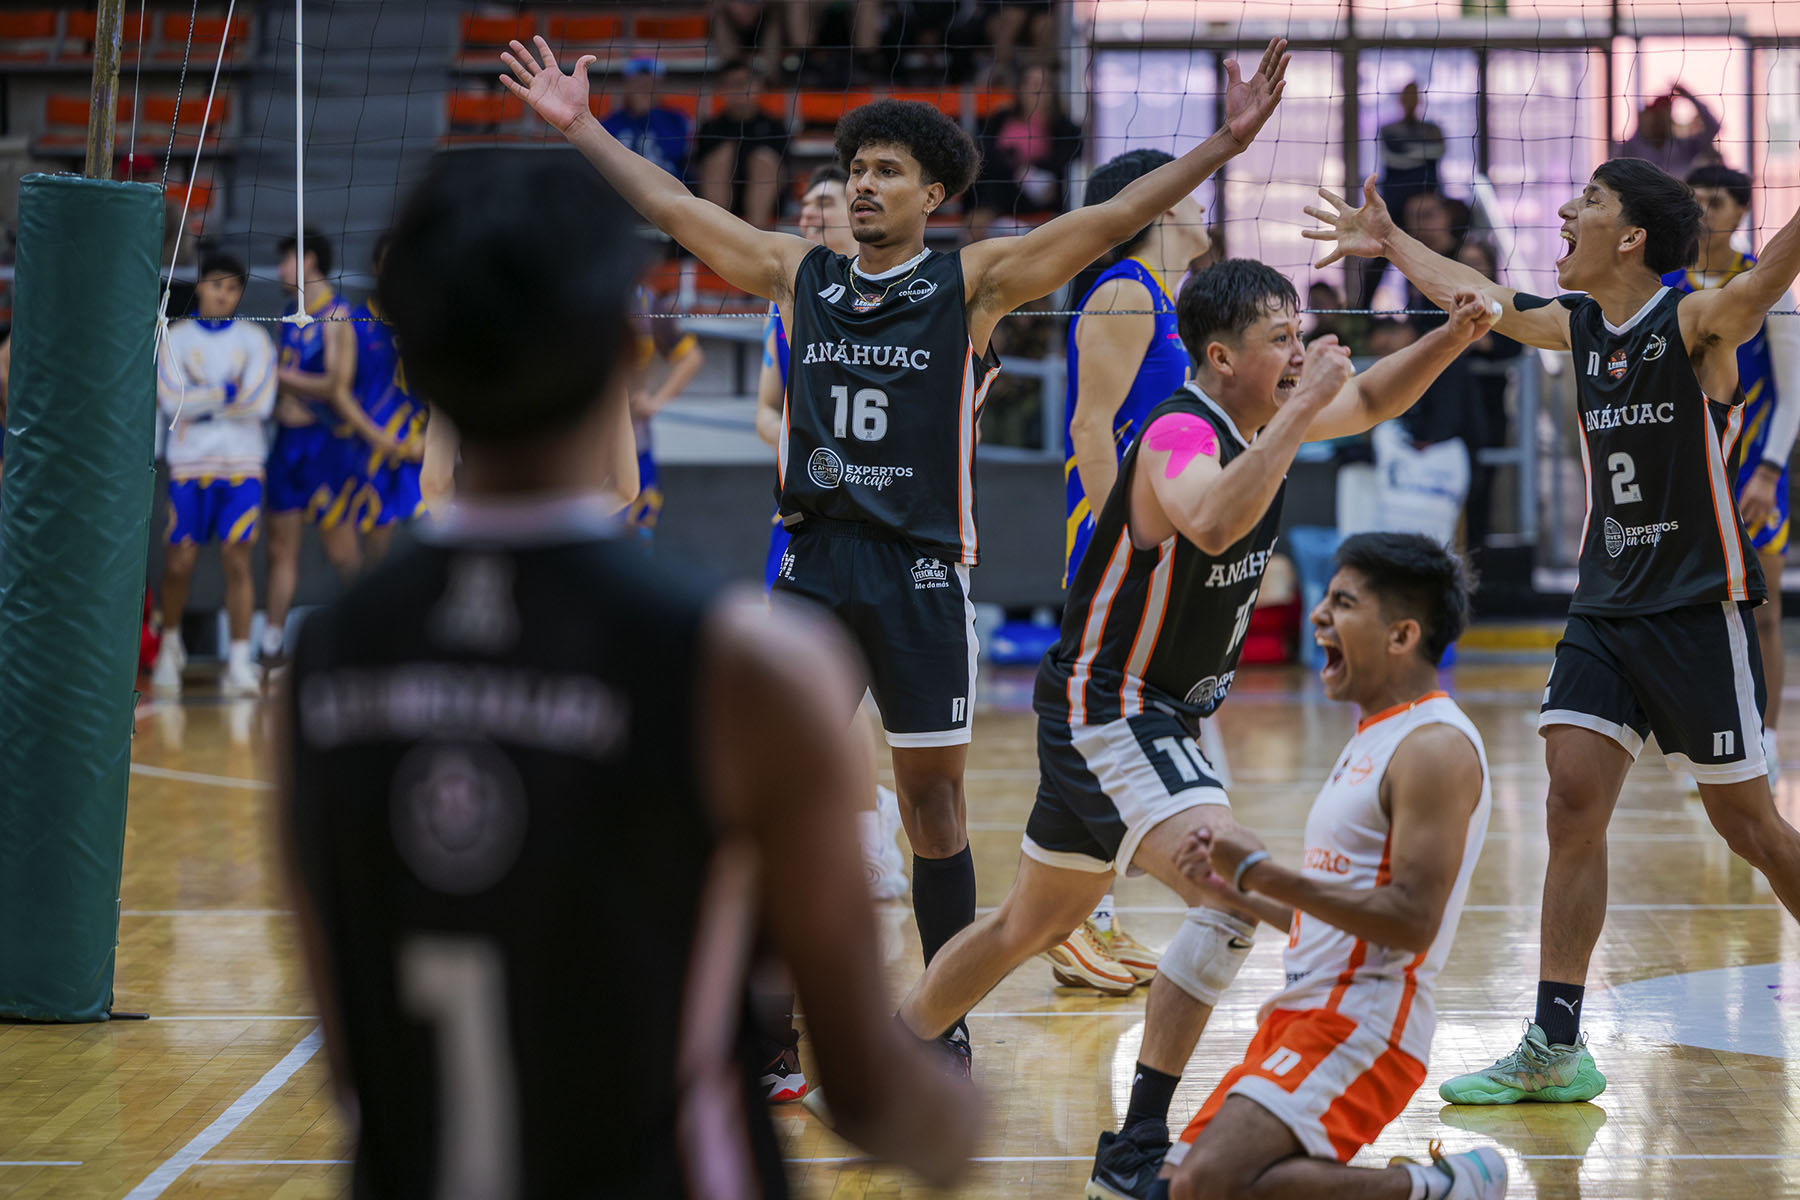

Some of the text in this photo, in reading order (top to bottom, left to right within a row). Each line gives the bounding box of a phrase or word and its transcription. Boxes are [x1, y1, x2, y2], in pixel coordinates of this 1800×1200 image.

[802, 339, 931, 371] ANÁHUAC
[830, 385, 889, 441] 16
[846, 464, 913, 477] EXPERTOS
[1607, 452, 1643, 505] 2
[844, 473, 893, 491] en café
[1625, 521, 1679, 536] EXPERTOS
[1626, 536, 1639, 546] en
